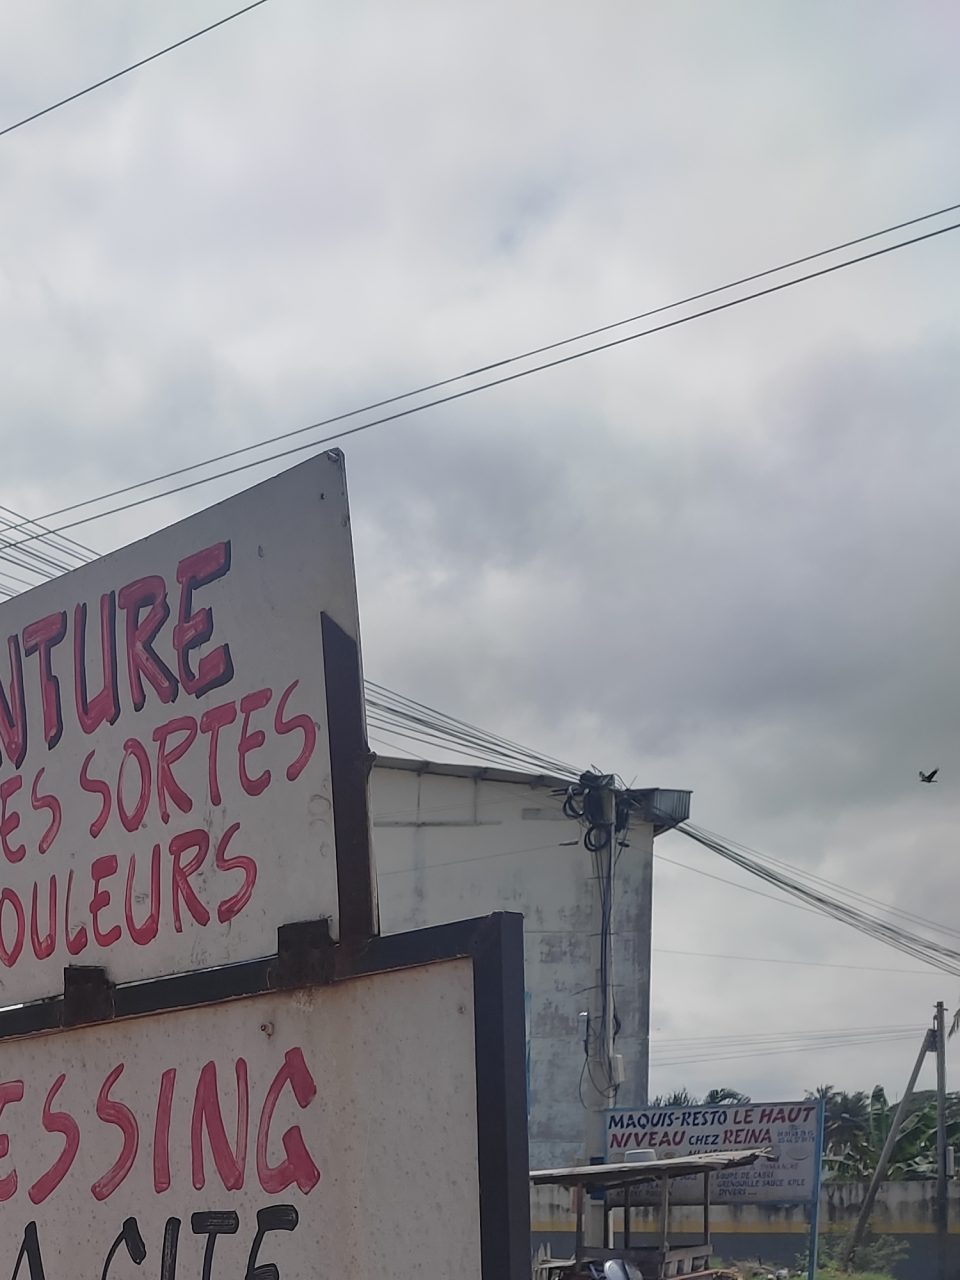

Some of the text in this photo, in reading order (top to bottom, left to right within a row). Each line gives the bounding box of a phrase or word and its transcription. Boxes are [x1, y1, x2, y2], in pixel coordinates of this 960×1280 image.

[78, 679, 316, 839] SORTES
[608, 1106, 817, 1130] MAQUIS-RESTO LE HAUT
[609, 1130, 686, 1149] NIVEAU
[688, 1134, 720, 1146] CHEZ
[722, 1127, 773, 1145] REINA
